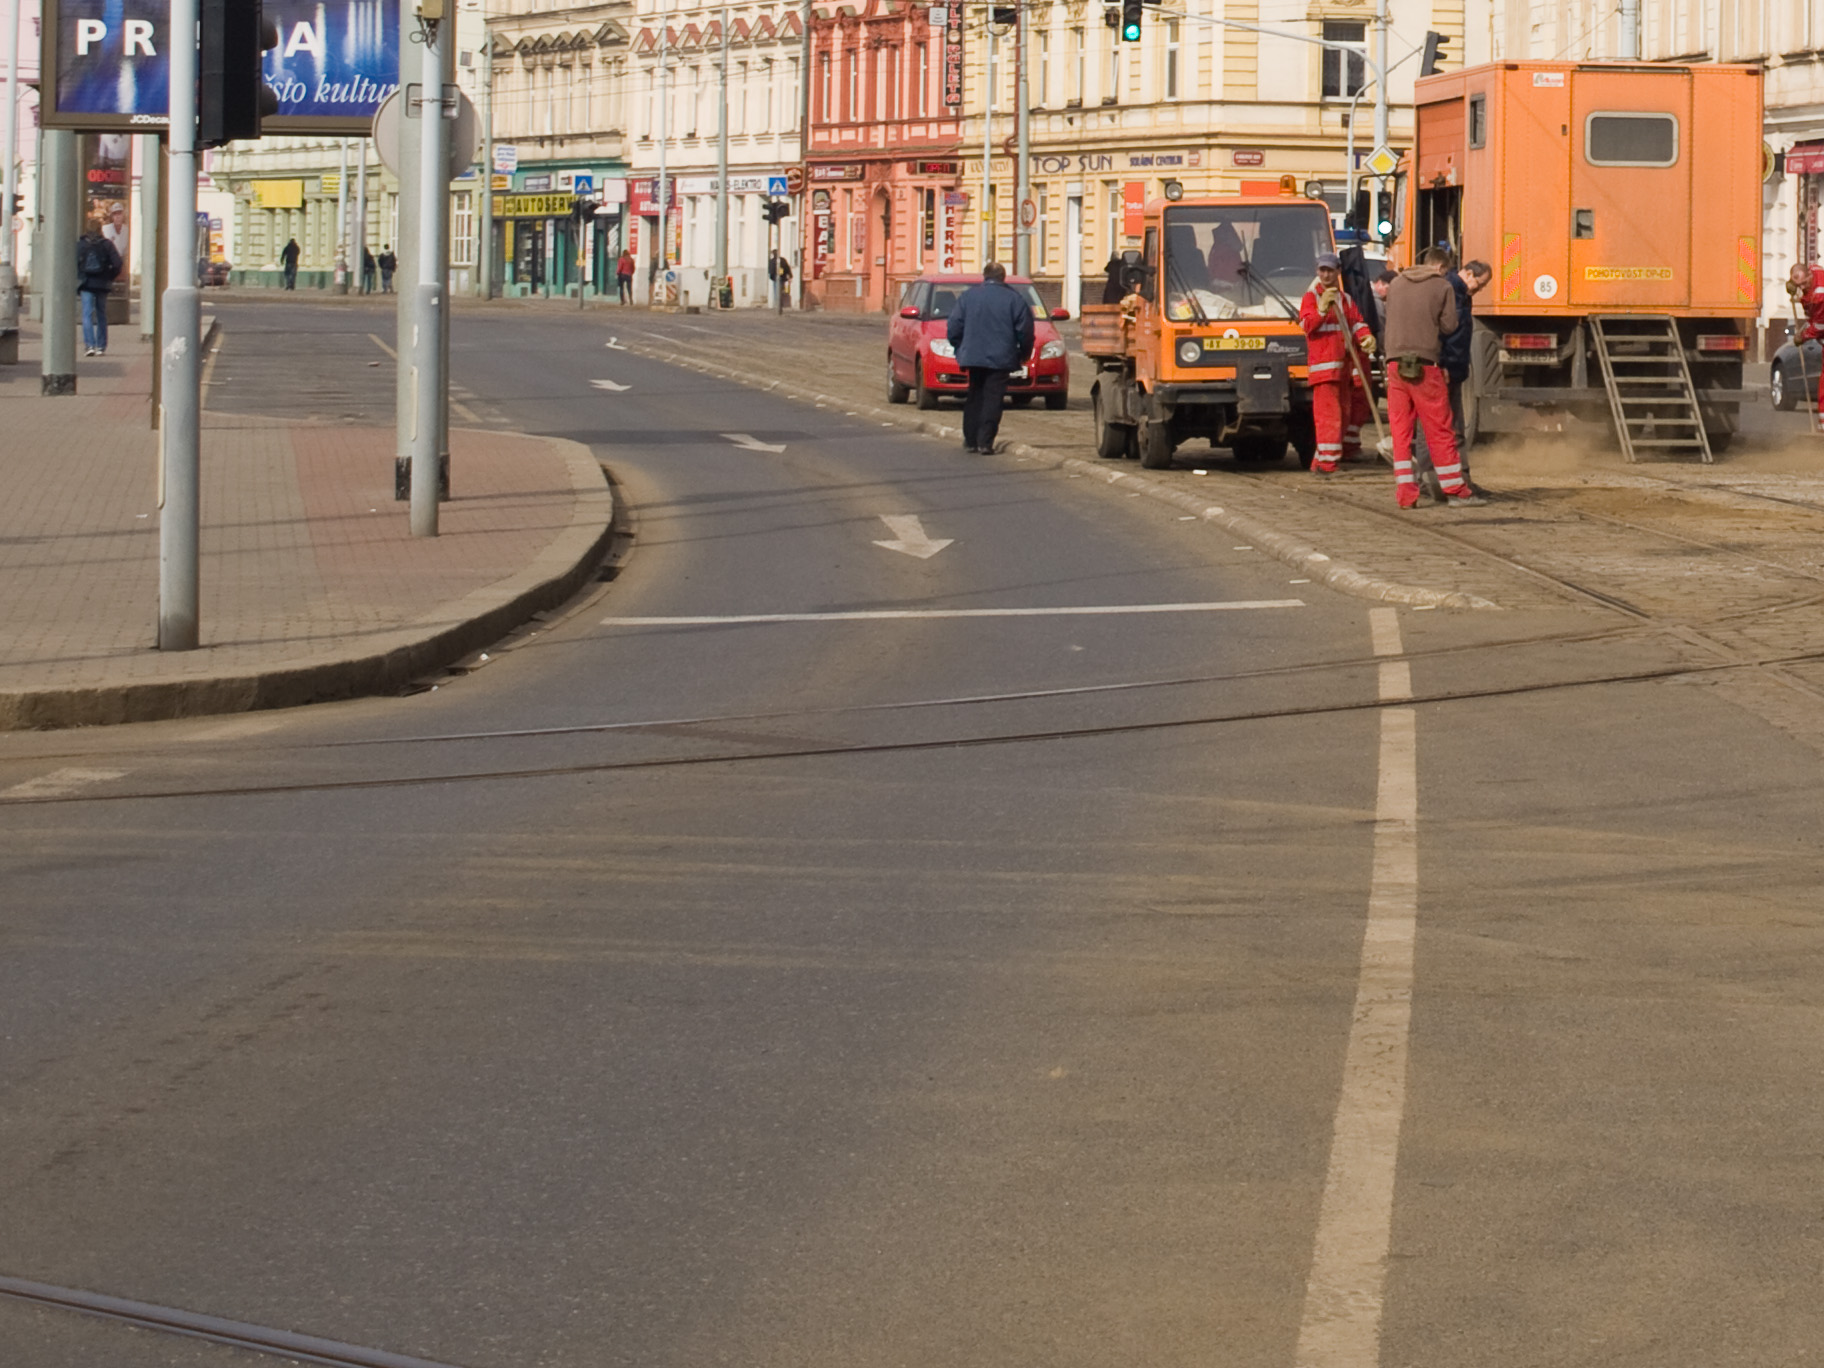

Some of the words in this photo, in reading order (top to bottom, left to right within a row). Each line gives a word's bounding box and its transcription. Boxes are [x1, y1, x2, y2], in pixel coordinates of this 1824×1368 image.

[76, 19, 322, 58] PRA
[313, 72, 400, 103] kultur
[1032, 155, 1071, 173] TOP
[1080, 154, 1113, 171] SUN
[1539, 281, 1552, 293] 85
